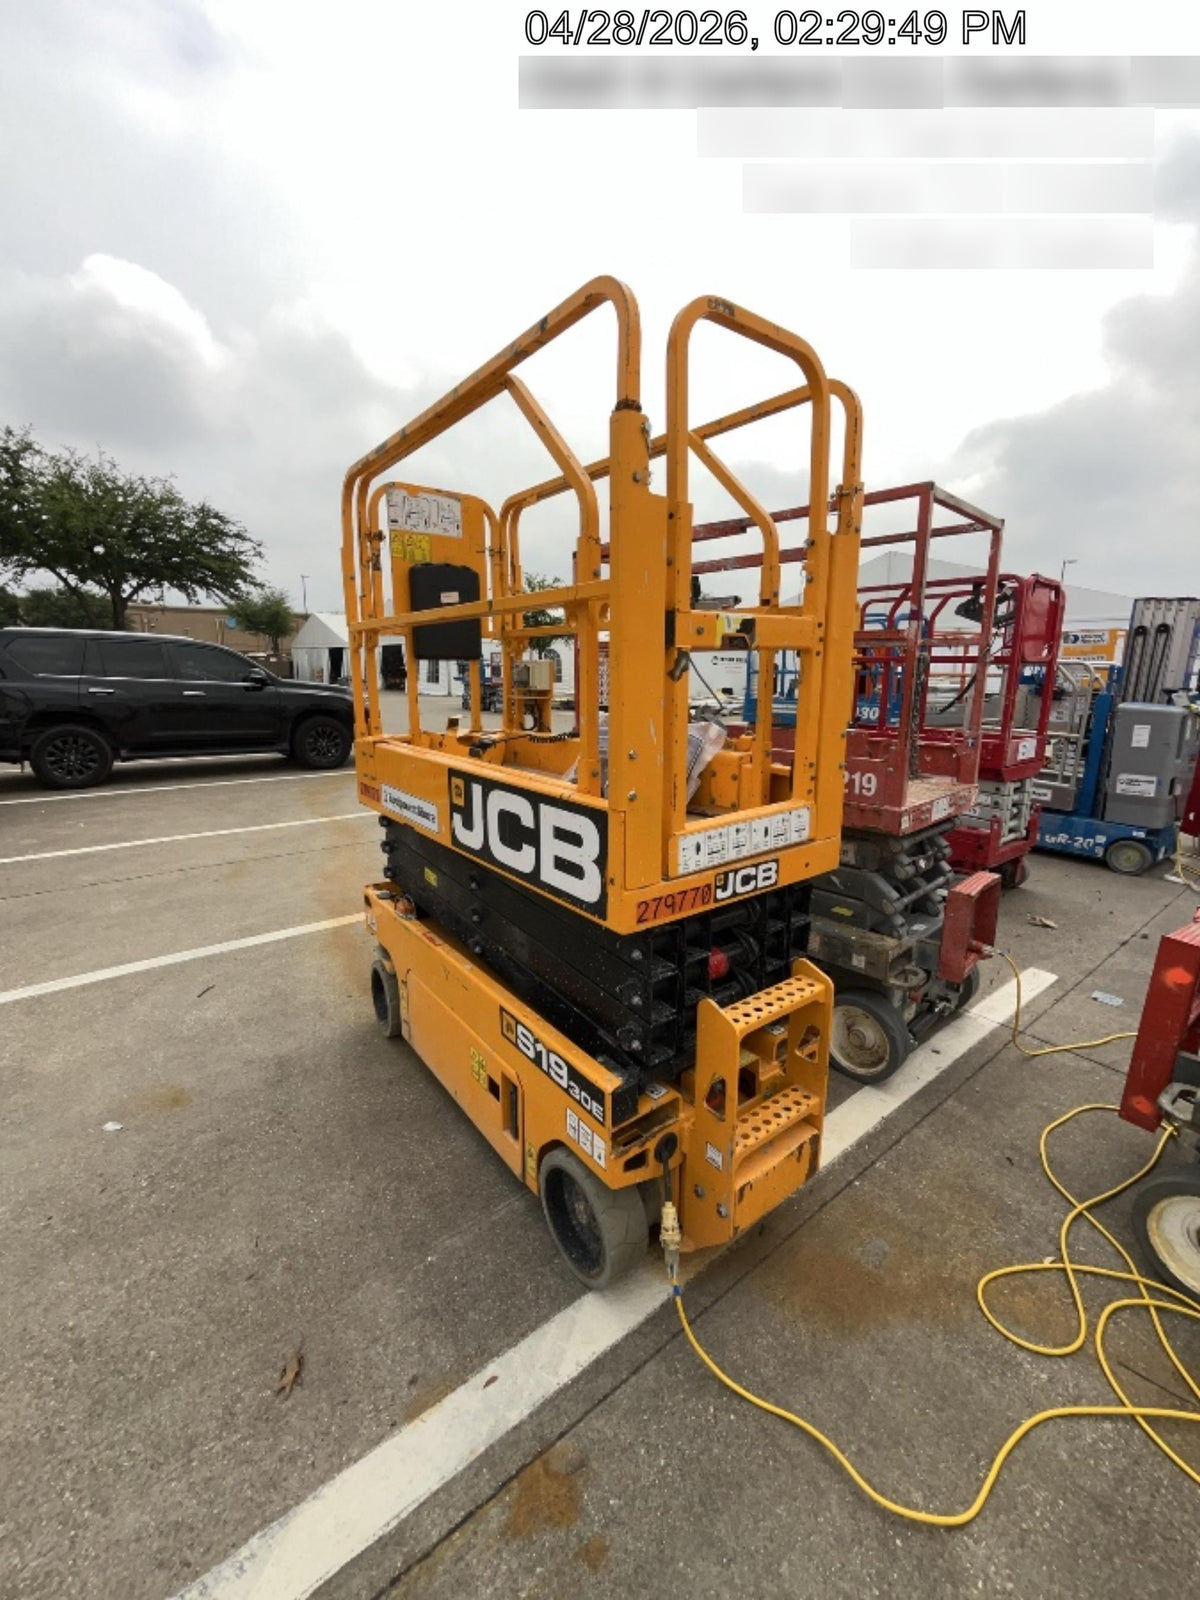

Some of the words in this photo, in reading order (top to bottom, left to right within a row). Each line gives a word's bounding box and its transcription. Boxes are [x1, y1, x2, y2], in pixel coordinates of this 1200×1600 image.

[452, 783, 603, 904] JCB
[715, 861, 778, 901] JCB
[637, 883, 713, 924] 279770
